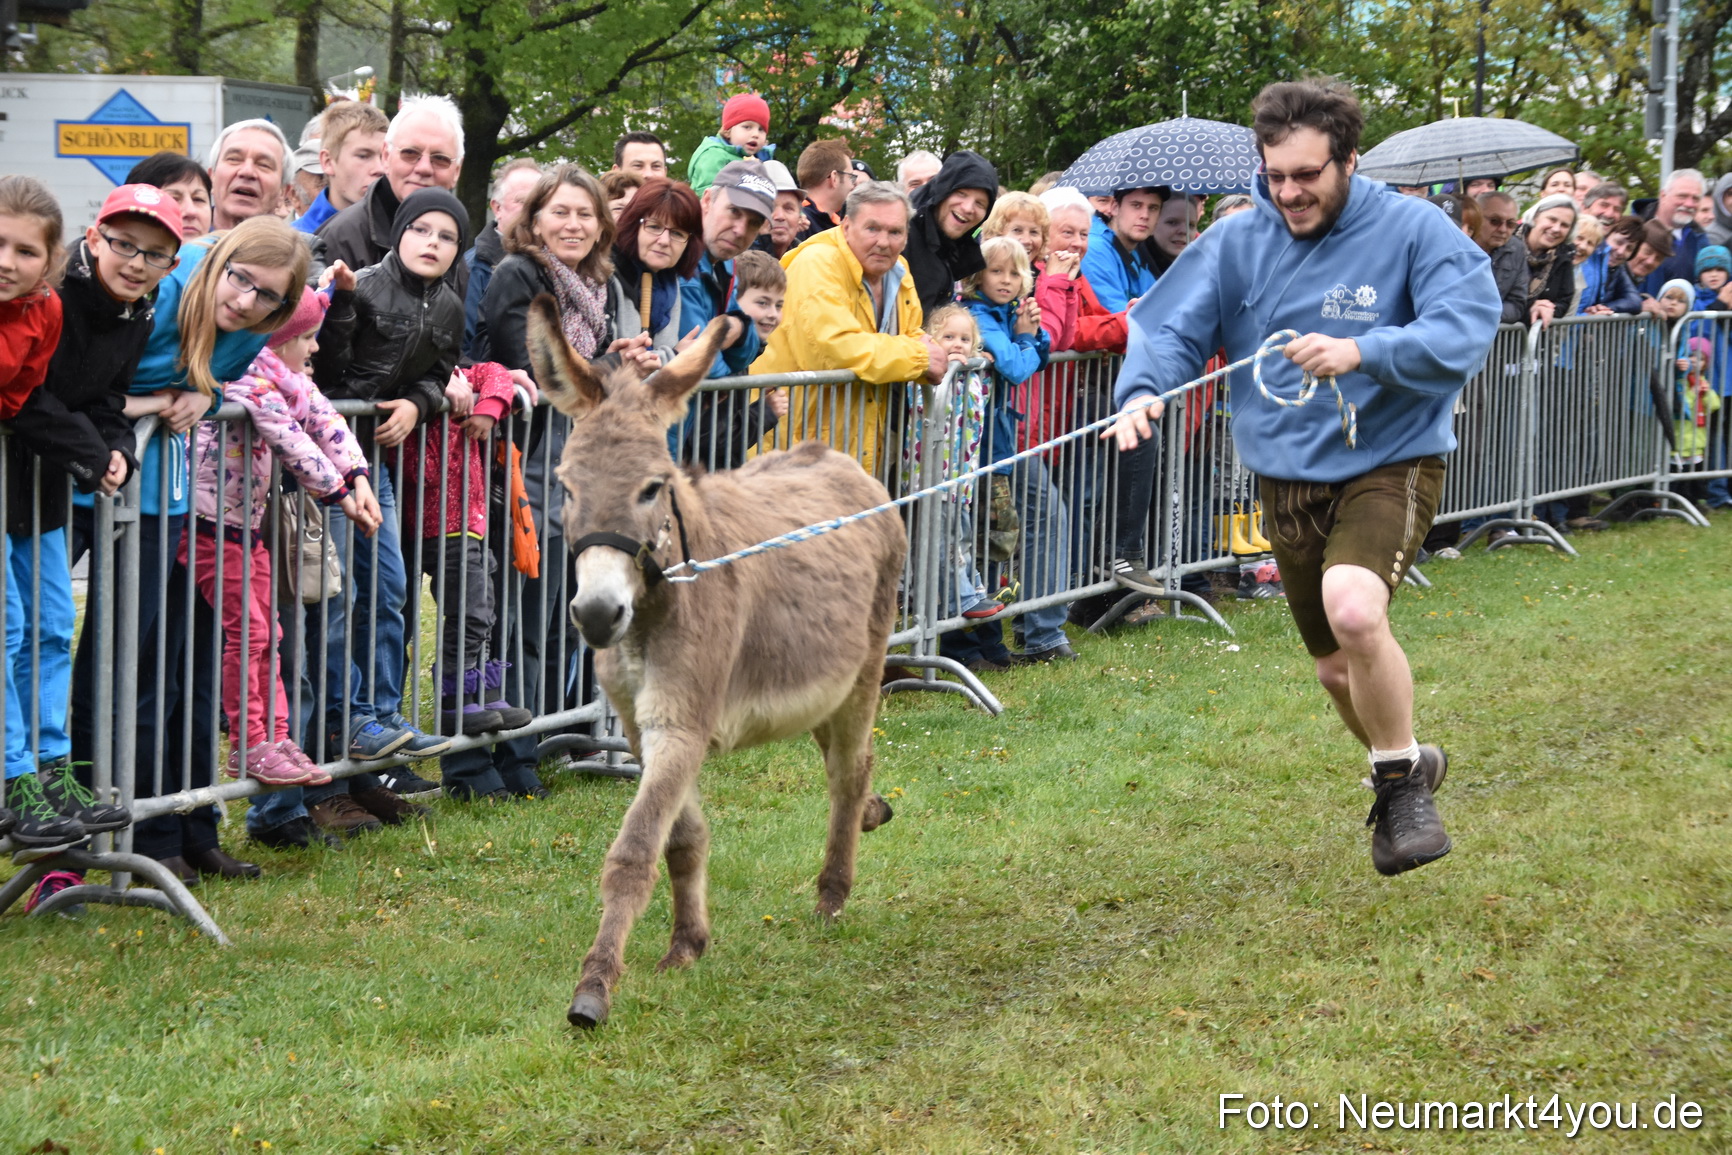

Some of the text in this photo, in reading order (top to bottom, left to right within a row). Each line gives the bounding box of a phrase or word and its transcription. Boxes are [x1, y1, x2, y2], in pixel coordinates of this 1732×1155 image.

[0, 86, 29, 99] ICK
[62, 127, 184, 149] SCHÖNBLICK
[1332, 289, 1345, 299] 40
